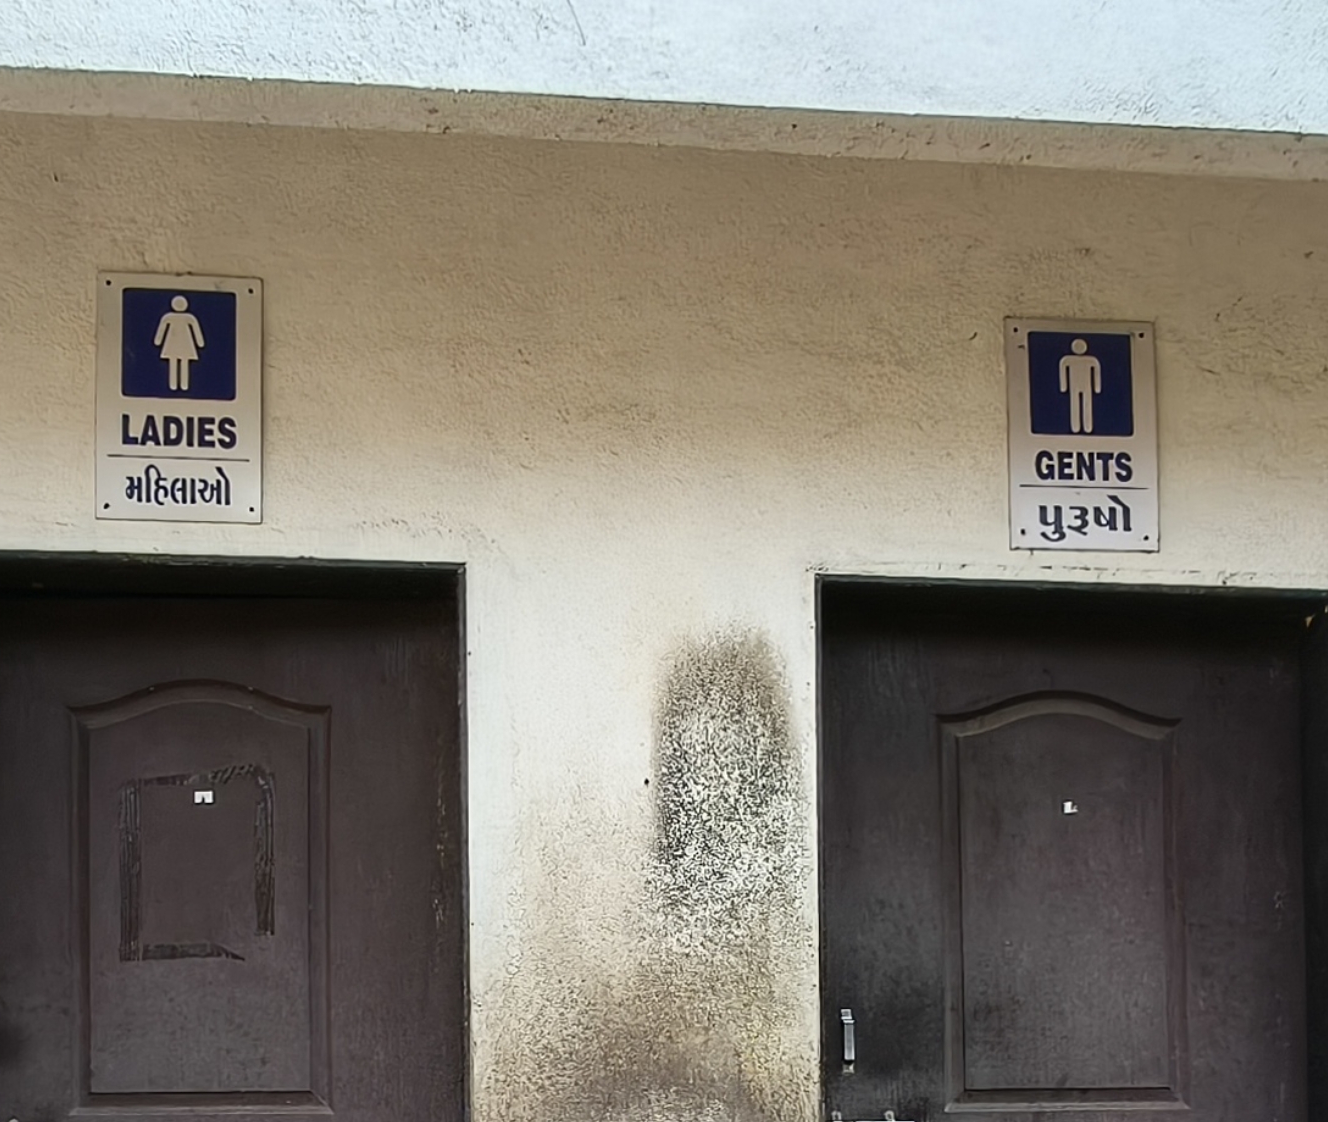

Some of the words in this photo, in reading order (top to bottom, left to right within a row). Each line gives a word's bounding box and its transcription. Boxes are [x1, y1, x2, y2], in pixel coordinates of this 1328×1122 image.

[121, 413, 237, 450] LADIES
[125, 464, 231, 506] મહિલાઓ
[1034, 450, 1133, 483] GENTS
